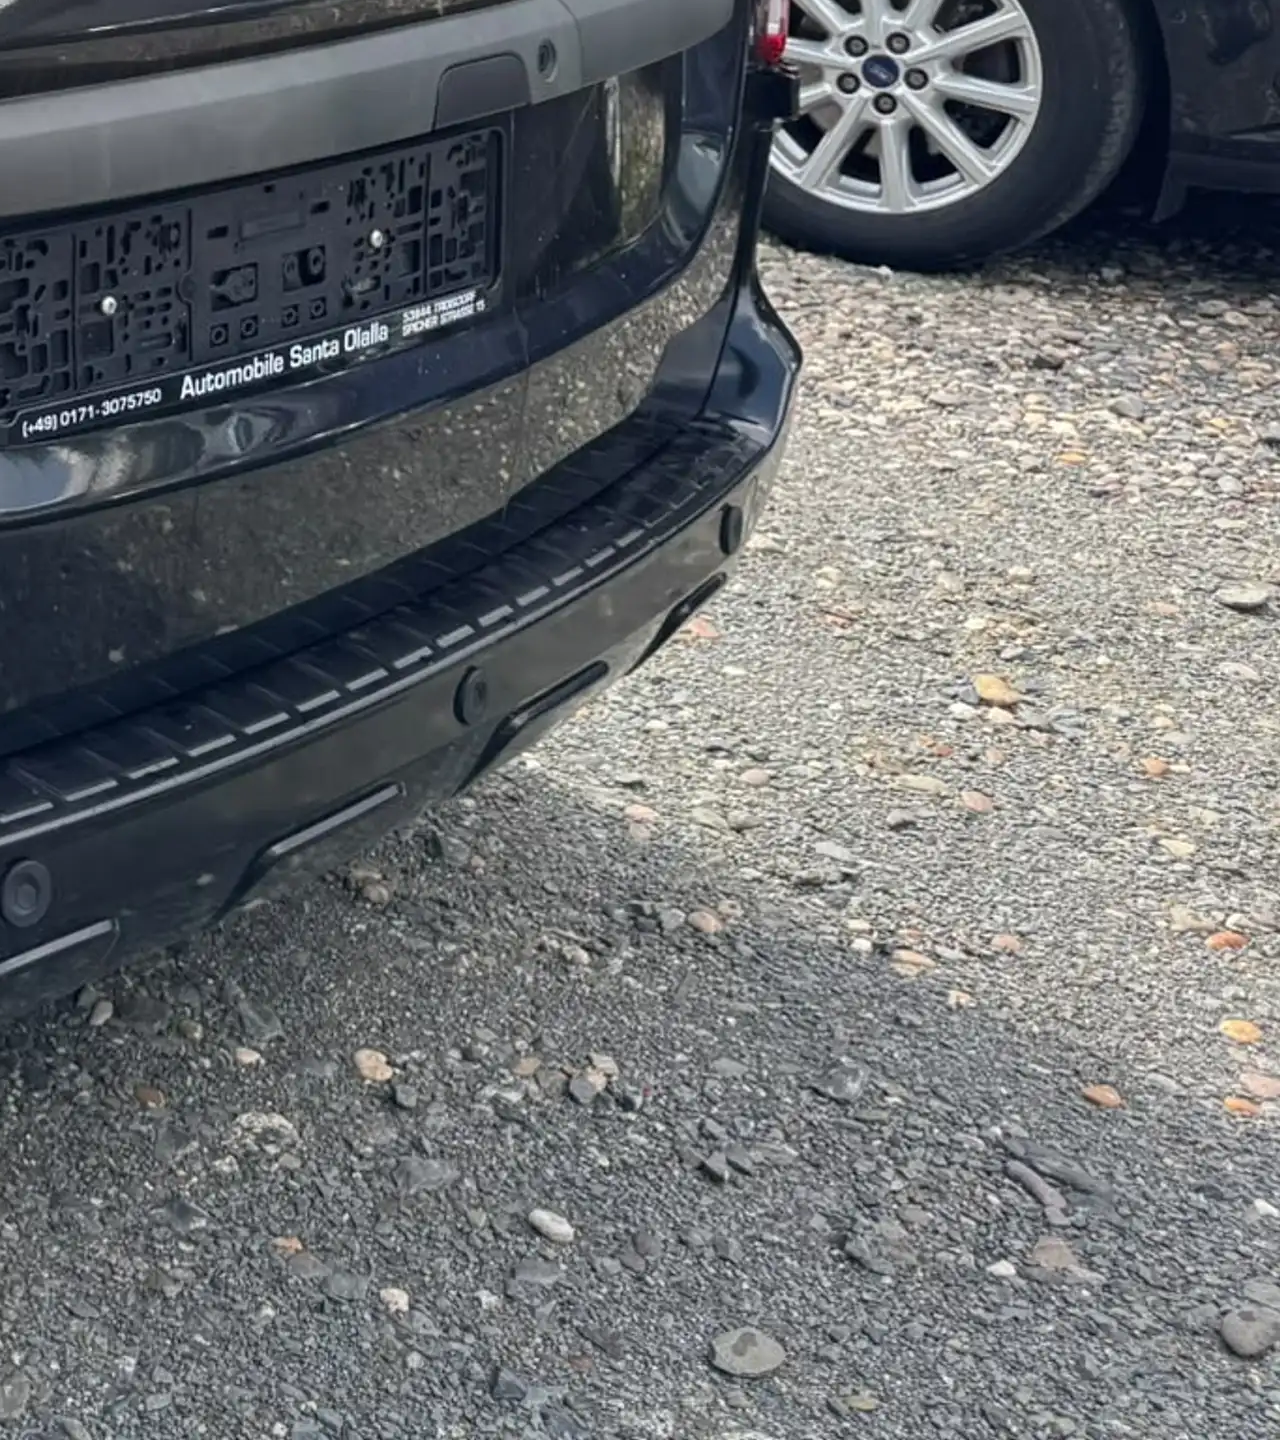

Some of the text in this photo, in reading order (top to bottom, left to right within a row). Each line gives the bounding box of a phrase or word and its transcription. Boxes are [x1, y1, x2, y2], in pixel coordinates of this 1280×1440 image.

[180, 321, 389, 400] Automobile Santa Olalla
